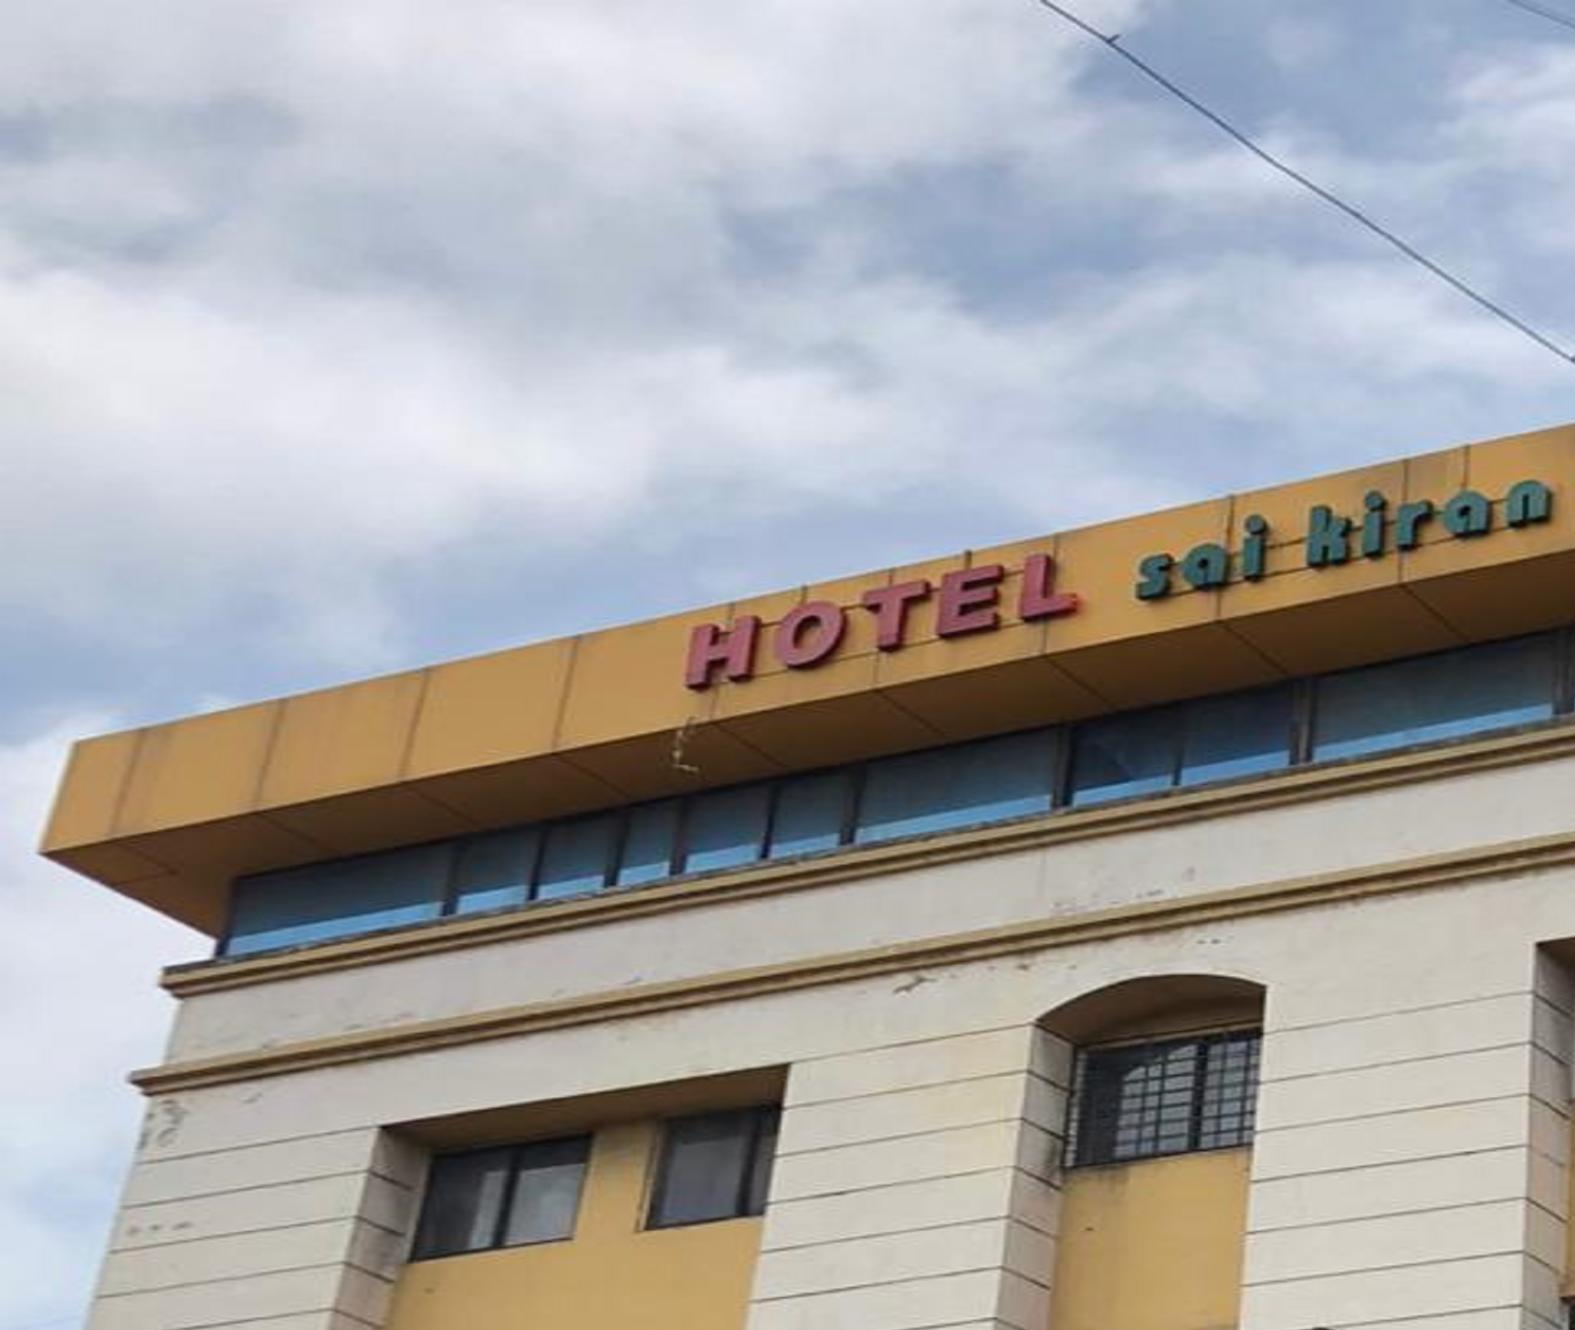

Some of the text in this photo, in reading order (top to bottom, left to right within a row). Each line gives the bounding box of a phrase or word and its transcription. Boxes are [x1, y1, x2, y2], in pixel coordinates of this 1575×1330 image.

[685, 478, 1553, 690] HOTEL sai kiran
